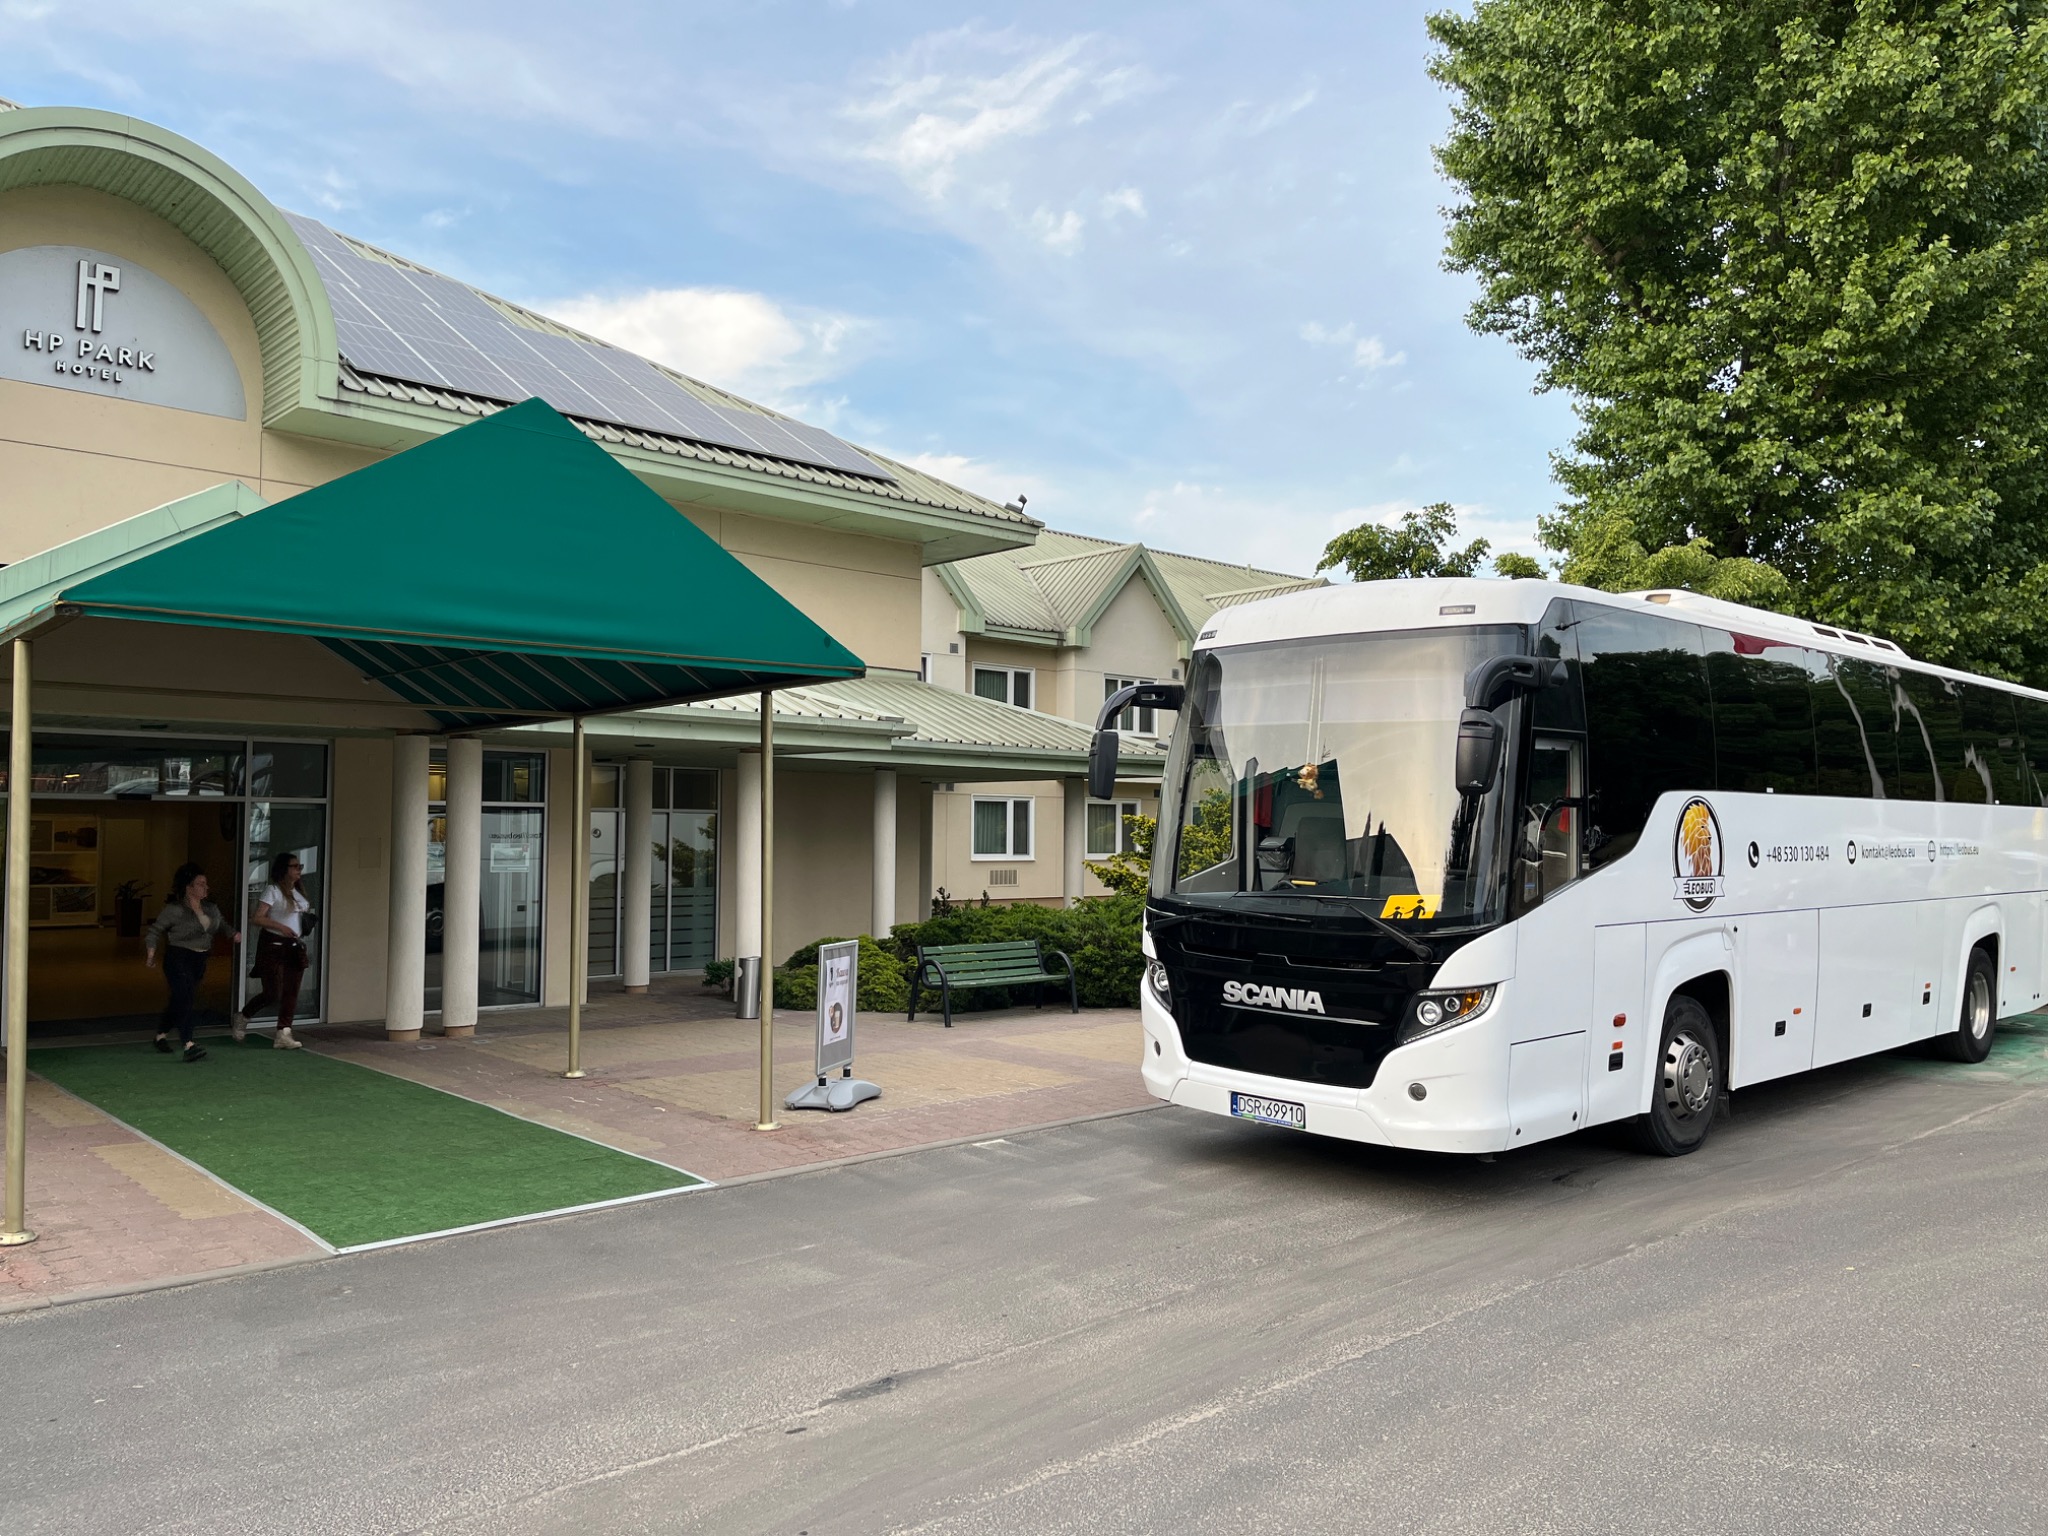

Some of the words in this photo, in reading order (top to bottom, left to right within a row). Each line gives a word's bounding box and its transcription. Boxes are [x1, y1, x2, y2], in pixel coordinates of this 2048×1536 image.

[24, 329, 64, 352] HP
[78, 339, 155, 371] PARK
[56, 361, 123, 382] HOTEL
[1766, 846, 1782, 862] +48
[1784, 846, 1798, 862] 530
[1800, 846, 1814, 861] 130
[1815, 846, 1829, 861] 484
[1861, 844, 1916, 860] kontakt@leobus.eu
[1686, 882, 1714, 895] LEOBUS
[1222, 980, 1326, 1014] SCANIA
